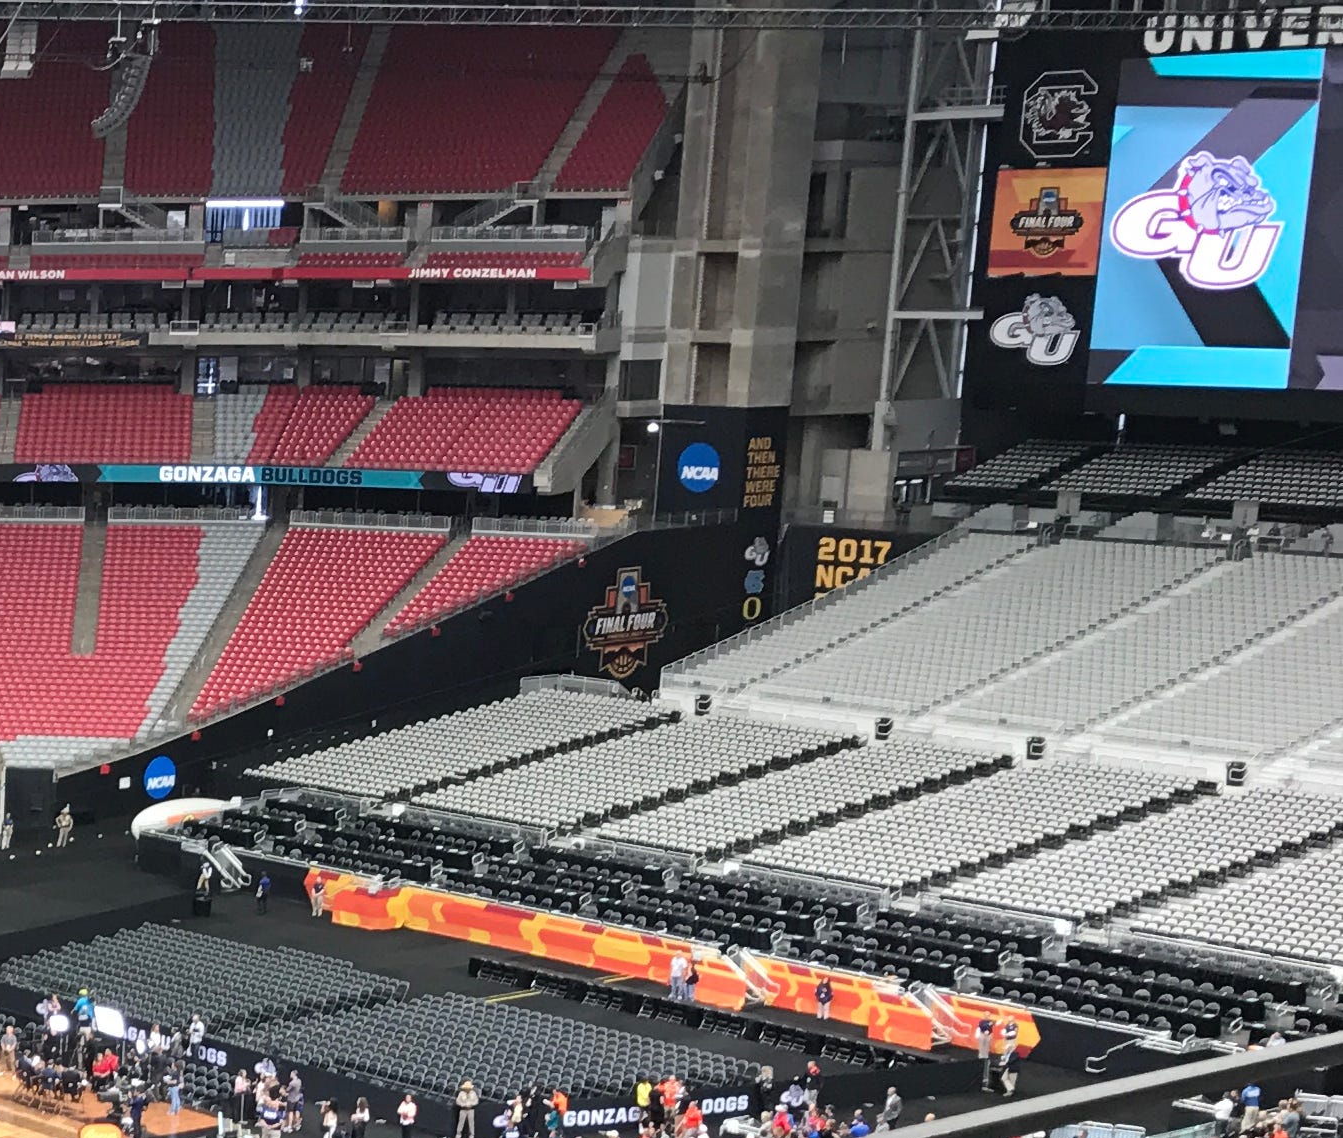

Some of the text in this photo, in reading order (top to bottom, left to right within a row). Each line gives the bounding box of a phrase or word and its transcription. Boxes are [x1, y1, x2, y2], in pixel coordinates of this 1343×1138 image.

[1019, 214, 1075, 229] FINAL FOUR
[17, 270, 66, 280] WILSON
[408, 268, 537, 278] JIMMY CONZELMAN
[748, 437, 772, 450] AND
[747, 451, 776, 464] THEN
[159, 466, 363, 485] GONZAGA BULLDOGS
[681, 466, 719, 481] NCAA
[746, 465, 781, 479] THERE
[745, 479, 776, 493] WERE
[743, 494, 773, 508] FOUR
[818, 536, 892, 565] 2017
[816, 564, 872, 589] NCA
[595, 611, 657, 636] FINAL FOUR
[146, 775, 176, 790] NCAA
[701, 1094, 749, 1115] DOGS
[563, 1107, 640, 1128] GONZAG
